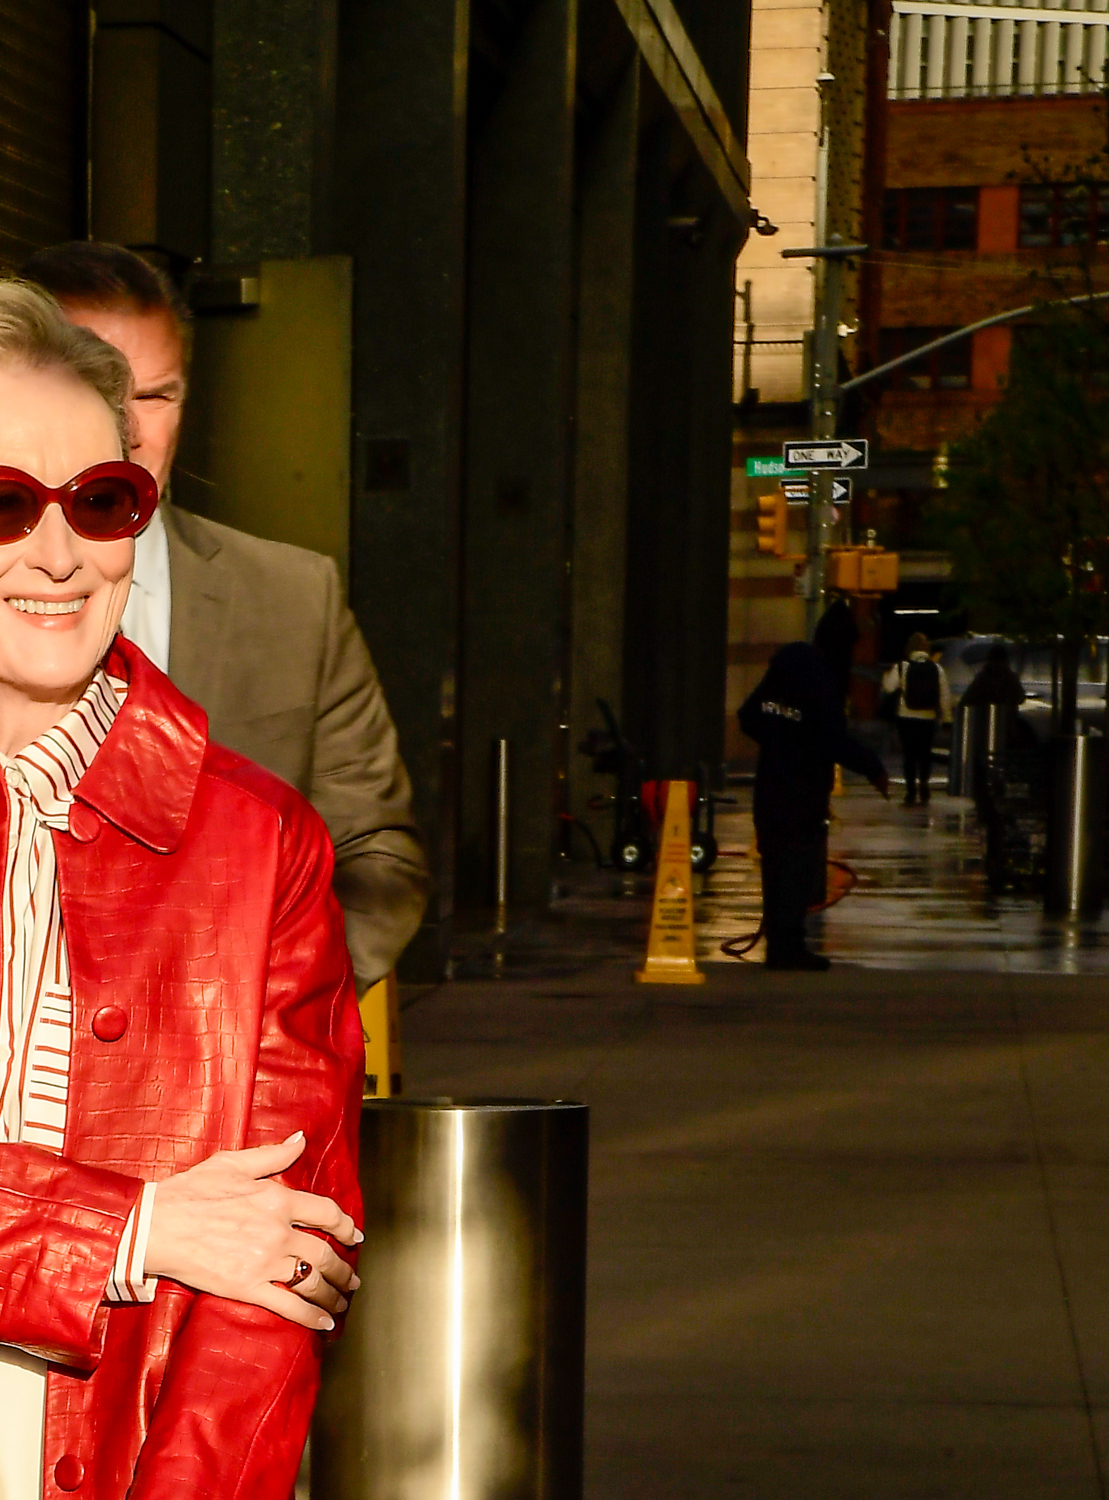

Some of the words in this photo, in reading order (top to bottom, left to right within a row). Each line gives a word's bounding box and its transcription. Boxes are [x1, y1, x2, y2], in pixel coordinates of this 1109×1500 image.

[793, 451, 815, 461] ONE
[826, 449, 851, 459] WAY
[754, 460, 785, 474] Hudso
